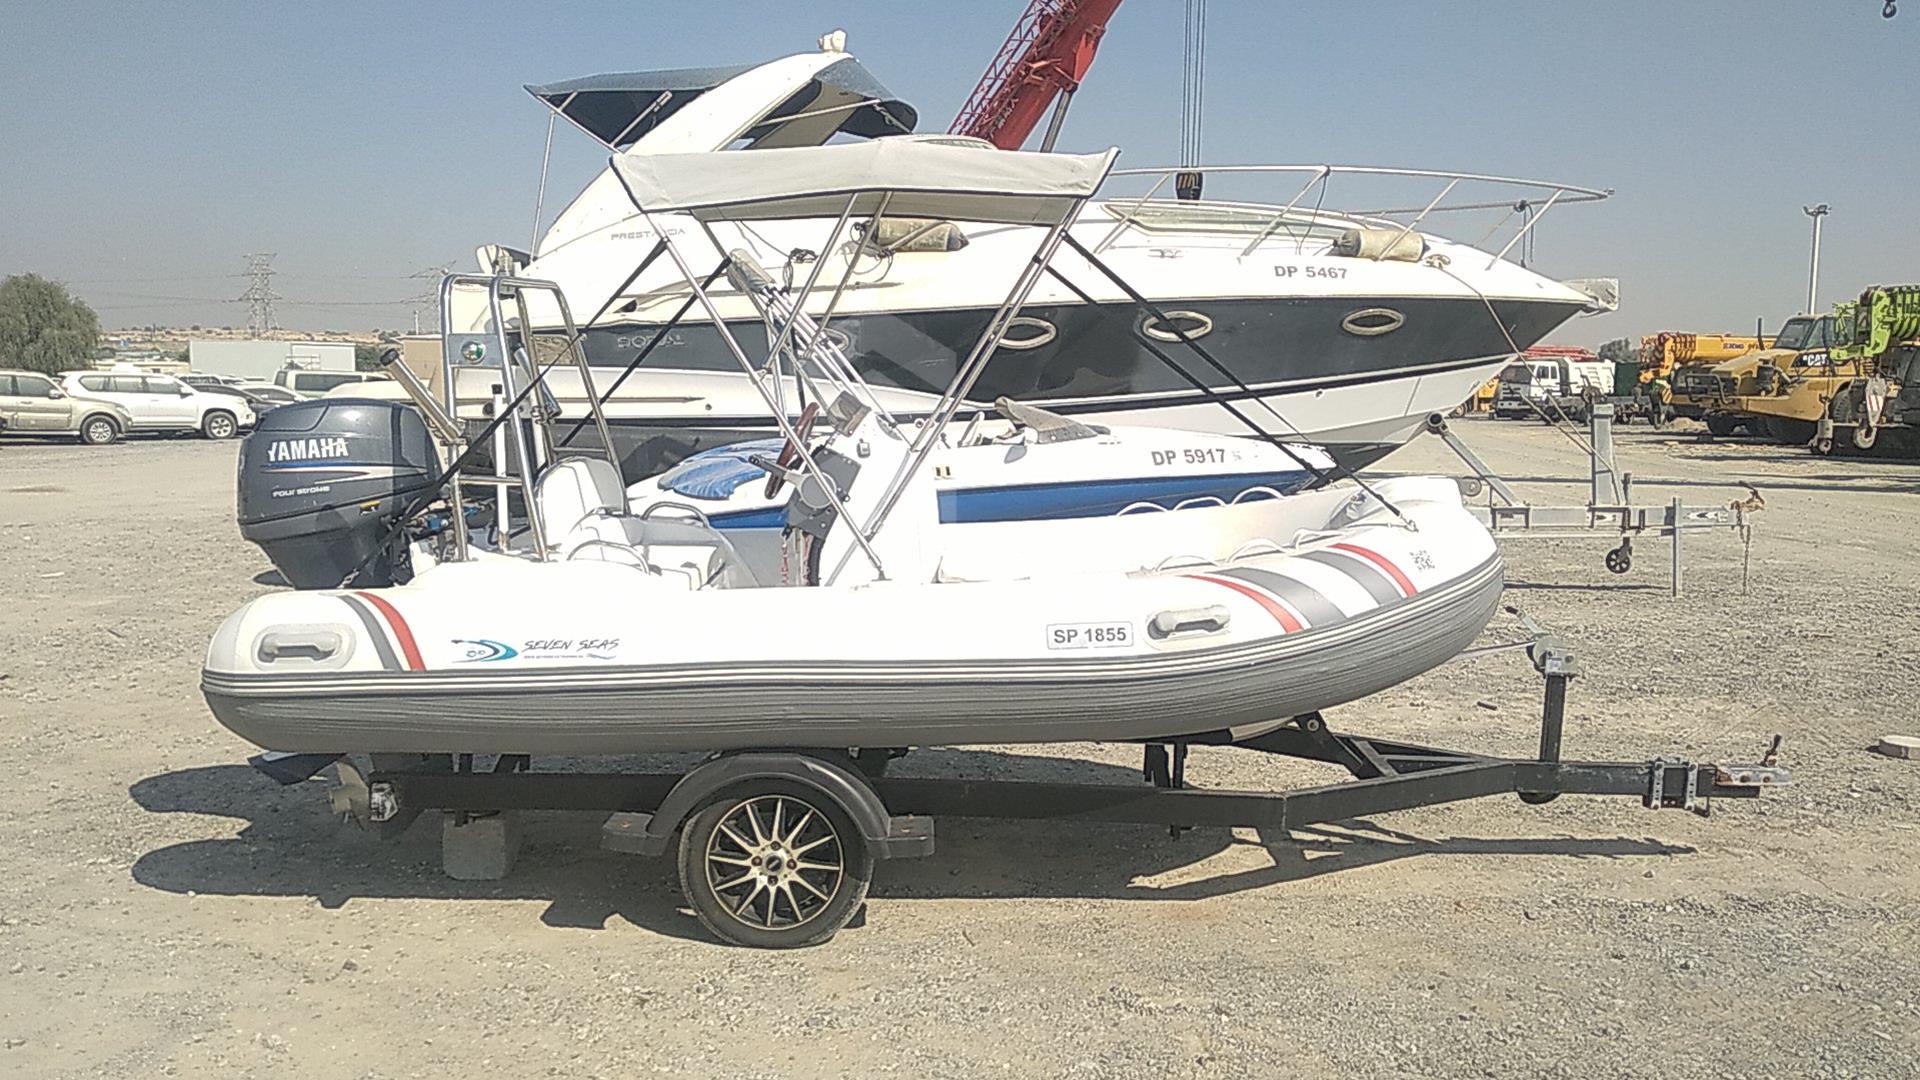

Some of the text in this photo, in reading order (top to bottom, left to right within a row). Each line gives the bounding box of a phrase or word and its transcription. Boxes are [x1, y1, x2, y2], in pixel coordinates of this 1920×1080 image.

[611, 228, 686, 241] PRESTCIA
[1274, 265, 1348, 279] DP 5467
[1807, 353, 1828, 366] CAT
[267, 437, 349, 463] YAMAHA
[1151, 450, 1177, 466] DP
[1183, 448, 1225, 464] 5917
[1053, 627, 1127, 644] SP 1855
[521, 638, 620, 652] SEVEN SEAS
